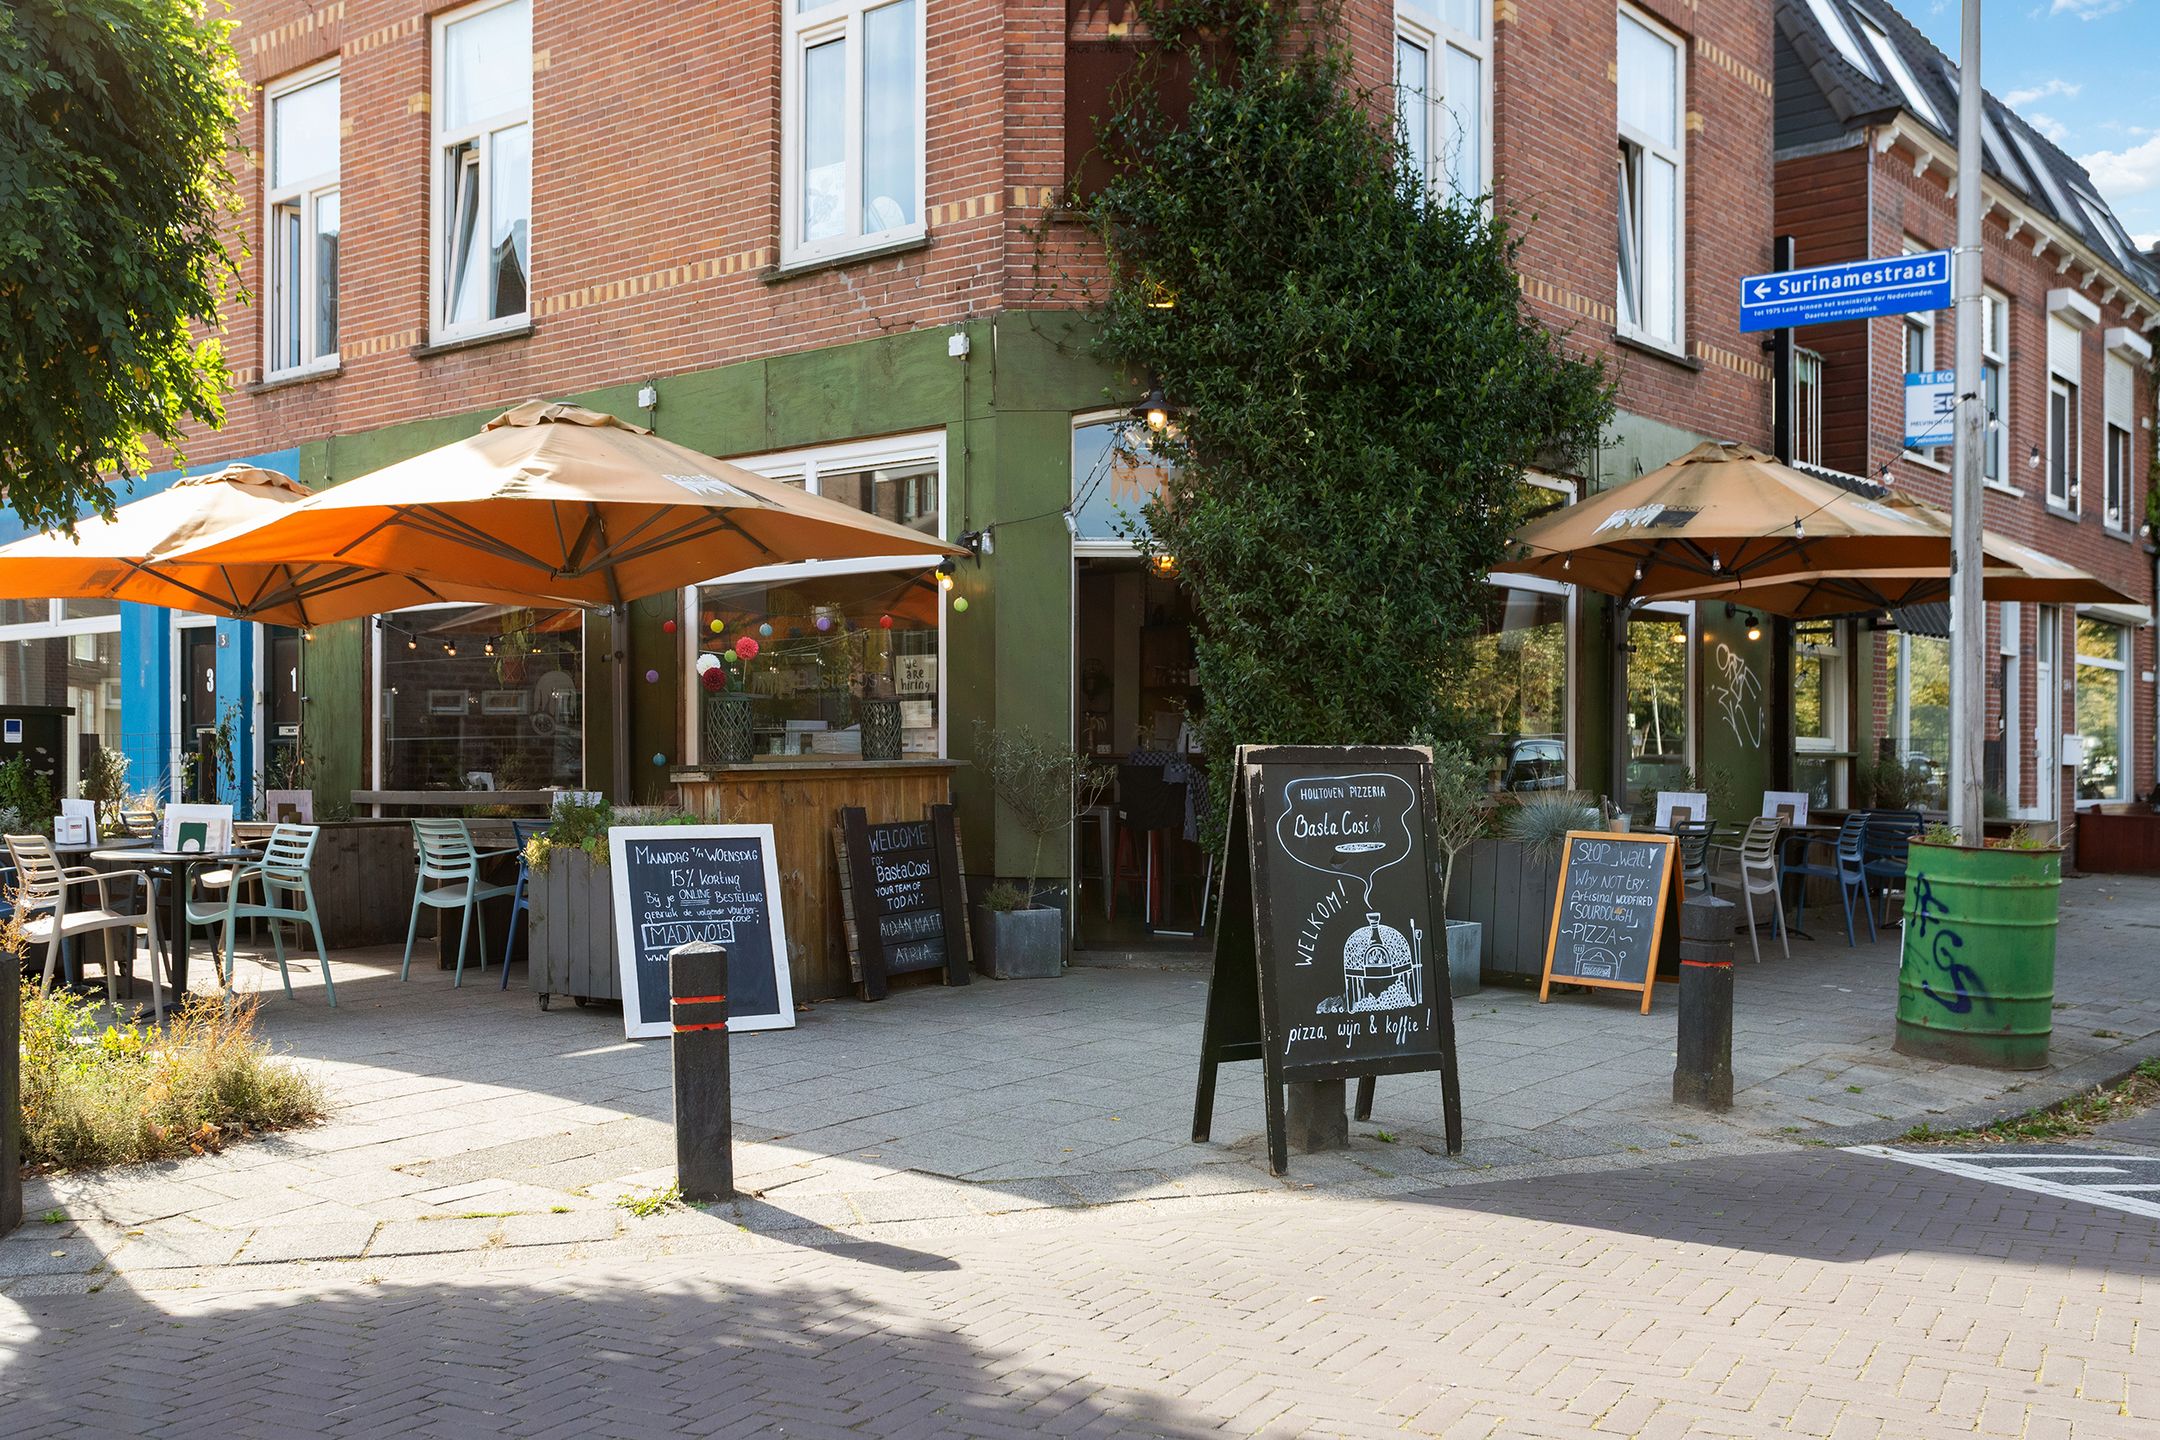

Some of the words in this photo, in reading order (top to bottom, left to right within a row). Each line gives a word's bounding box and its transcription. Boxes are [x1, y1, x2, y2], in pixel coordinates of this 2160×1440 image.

[1779, 261, 1936, 296] Surinamestraat
[1754, 309, 1764, 317] tot
[1766, 307, 1781, 315] 1975
[1782, 305, 1798, 313] Land
[1799, 302, 1822, 311] binnen
[1824, 300, 1836, 308] het
[1837, 296, 1872, 307] koninkrijk
[1874, 294, 1886, 302] der
[1804, 311, 1829, 319] Daarna
[1919, 374, 1934, 384] TE
[1937, 372, 1955, 383] KO
[206, 668, 214, 692] 3
[290, 667, 297, 692] 1
[900, 679, 930, 694] hiring
[1300, 787, 1345, 800] HOUTOVEN
[1349, 786, 1387, 798] PIZZERIA
[1293, 811, 1339, 839] Basta
[1341, 810, 1370, 837] Cosi
[868, 824, 928, 853] WELCOME
[670, 868, 694, 887] 15%
[876, 859, 931, 883] BastaCosi
[1575, 869, 1598, 890] Why
[1600, 875, 1624, 889] NOT
[644, 890, 661, 908] Bij
[665, 894, 675, 908] je
[875, 885, 895, 897] YOUR
[895, 883, 912, 893] TEAM
[912, 882, 921, 891] OF
[887, 893, 925, 910] TODAY:
[1615, 895, 1653, 907] WOODFIRED
[683, 907, 693, 917] de
[696, 908, 725, 919] volgende
[1573, 903, 1633, 923] SOURDOUGH
[1295, 879, 1350, 968] WELKOM!
[645, 953, 669, 962] www
[1285, 1021, 1328, 1056] pizza,
[1337, 1020, 1361, 1049] wijn
[1369, 1015, 1379, 1034] &
